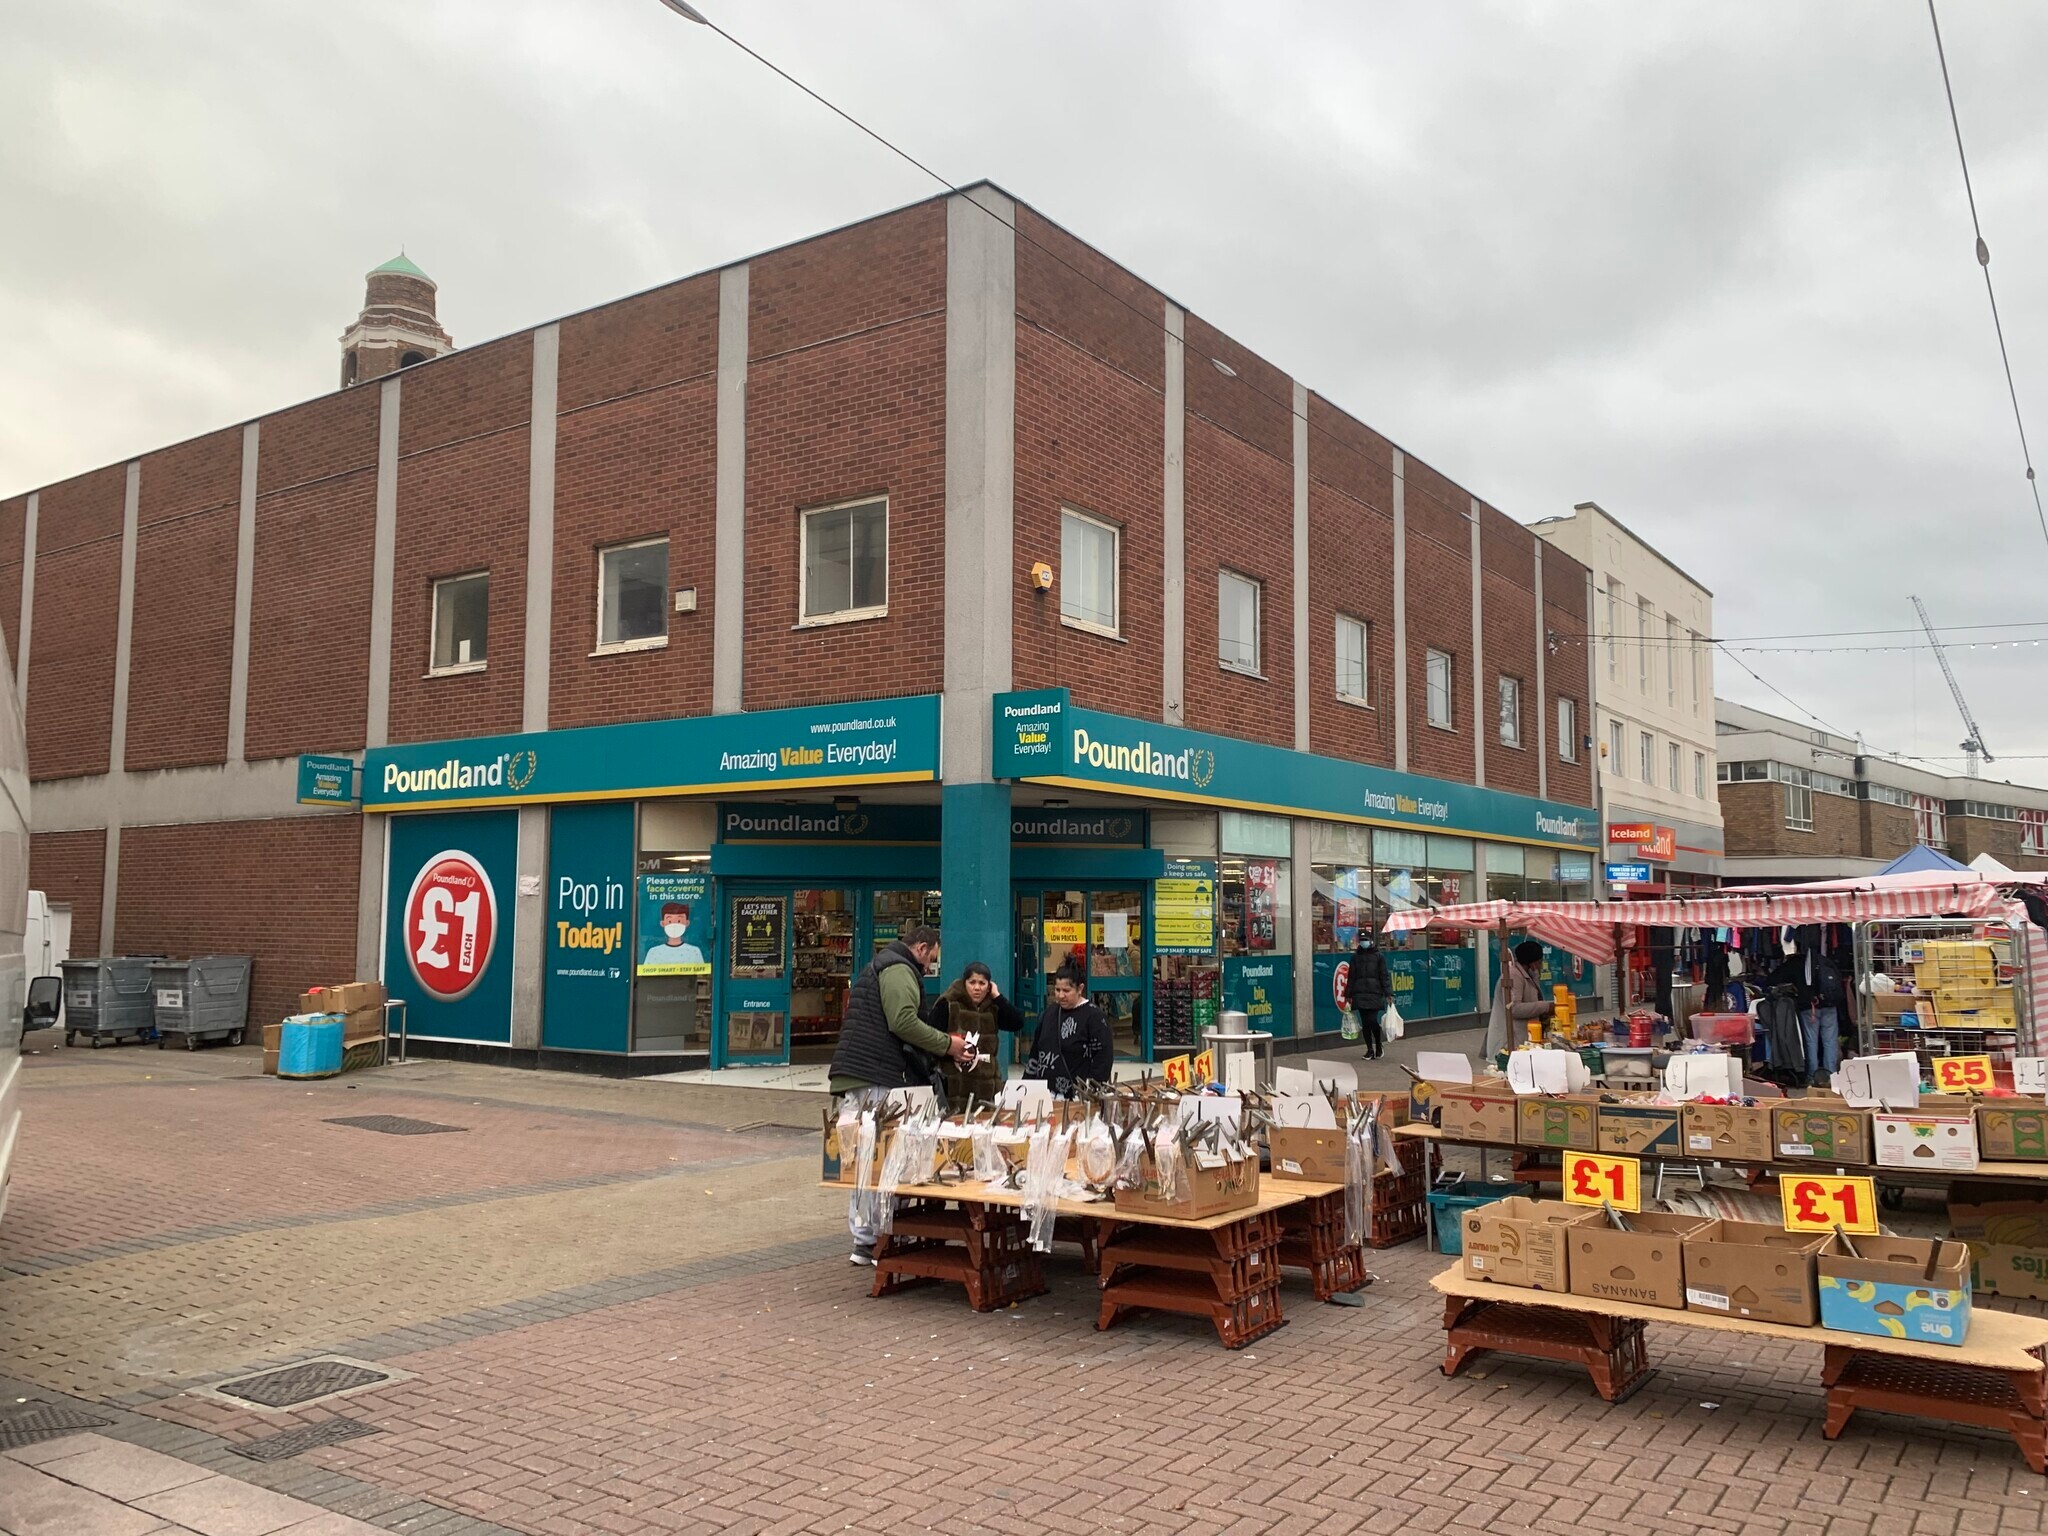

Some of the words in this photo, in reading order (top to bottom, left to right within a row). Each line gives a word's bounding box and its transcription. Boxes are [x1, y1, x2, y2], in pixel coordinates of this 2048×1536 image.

[1004, 702, 1061, 718] Poundland
[810, 716, 897, 734] www.poundland.co.uk
[1015, 721, 1050, 733] Amazing
[1019, 732, 1047, 744] Value
[719, 750, 777, 772] Amazing
[780, 746, 823, 766] Value
[827, 739, 897, 766] Everyday!
[1014, 741, 1052, 755] Everyday!
[1073, 729, 1190, 780] Poundland
[306, 760, 350, 772] Poundland
[383, 756, 503, 793] Poundland
[315, 773, 342, 784] Amazing
[312, 786, 343, 798] Everyday!
[1364, 788, 1396, 815] Amazing
[1396, 794, 1417, 814] Value
[1418, 797, 1448, 822] Everyday!
[726, 813, 840, 832] Poundland
[1011, 819, 1105, 836] oundland
[1536, 811, 1577, 837] Poundland
[1611, 829, 1650, 839] Iceland
[1167, 863, 1186, 871] Doing
[432, 873, 467, 886] Poundland
[646, 877, 675, 885] Please
[559, 876, 599, 917] Pop
[605, 875, 624, 910] in
[667, 885, 705, 893] covering
[416, 886, 481, 974] £1
[556, 921, 622, 955] Today!
[462, 933, 473, 966] EACH
[556, 967, 606, 977] www.poundland.co.uk
[1242, 965, 1273, 978] Poundland
[1392, 959, 1412, 972] Amazing
[1391, 972, 1414, 992] Value
[1253, 986, 1266, 1003] big
[743, 1000, 771, 1008] Entrance
[1247, 1002, 1273, 1016] brands
[1167, 1060, 1186, 1087] £1
[1941, 1061, 1987, 1087] £5
[1572, 1159, 1625, 1201] £1
[1792, 1181, 1859, 1224] £1
[1592, 1283, 1657, 1300] BANANAS
[1920, 1322, 1953, 1339] One
